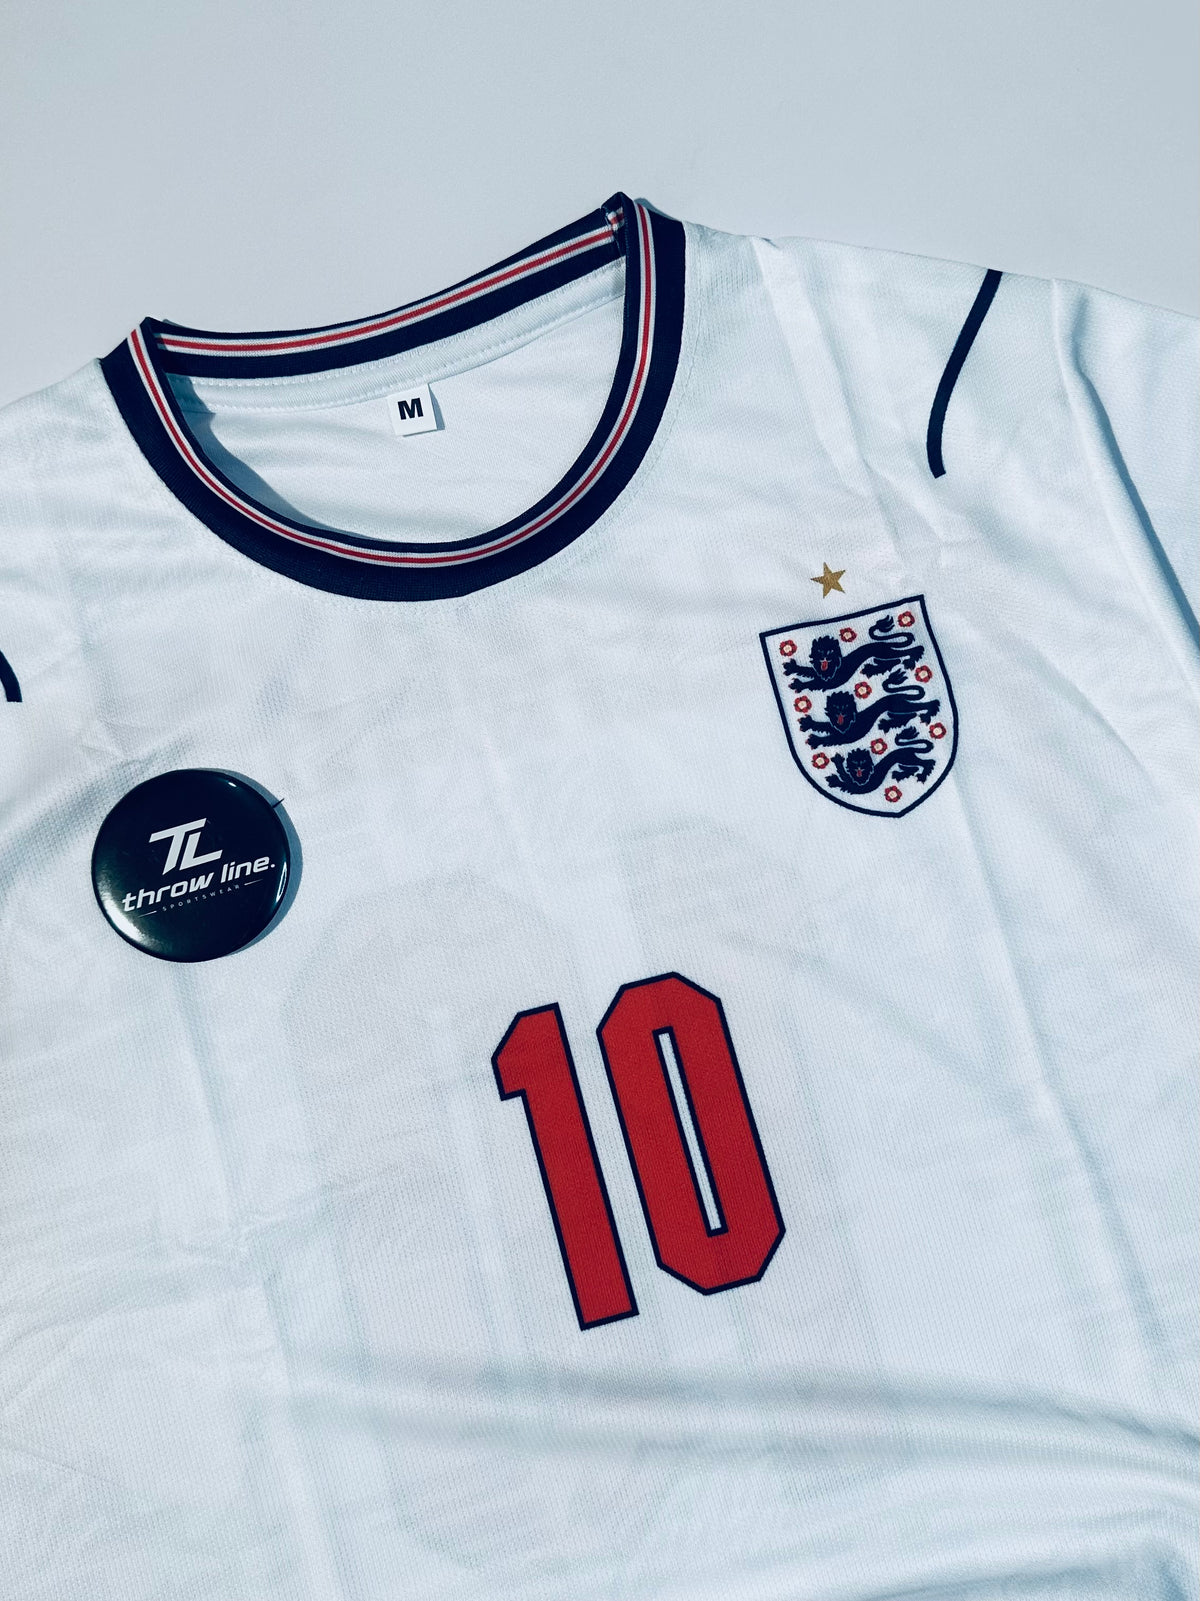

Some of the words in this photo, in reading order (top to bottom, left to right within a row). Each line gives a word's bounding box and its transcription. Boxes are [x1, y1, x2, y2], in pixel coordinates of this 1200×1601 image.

[397, 397, 424, 421] M
[148, 817, 223, 875] TL
[122, 872, 215, 912] throw
[220, 856, 276, 884] line.
[162, 884, 240, 912] SPORTSWEAR
[491, 971, 786, 1331] 10
